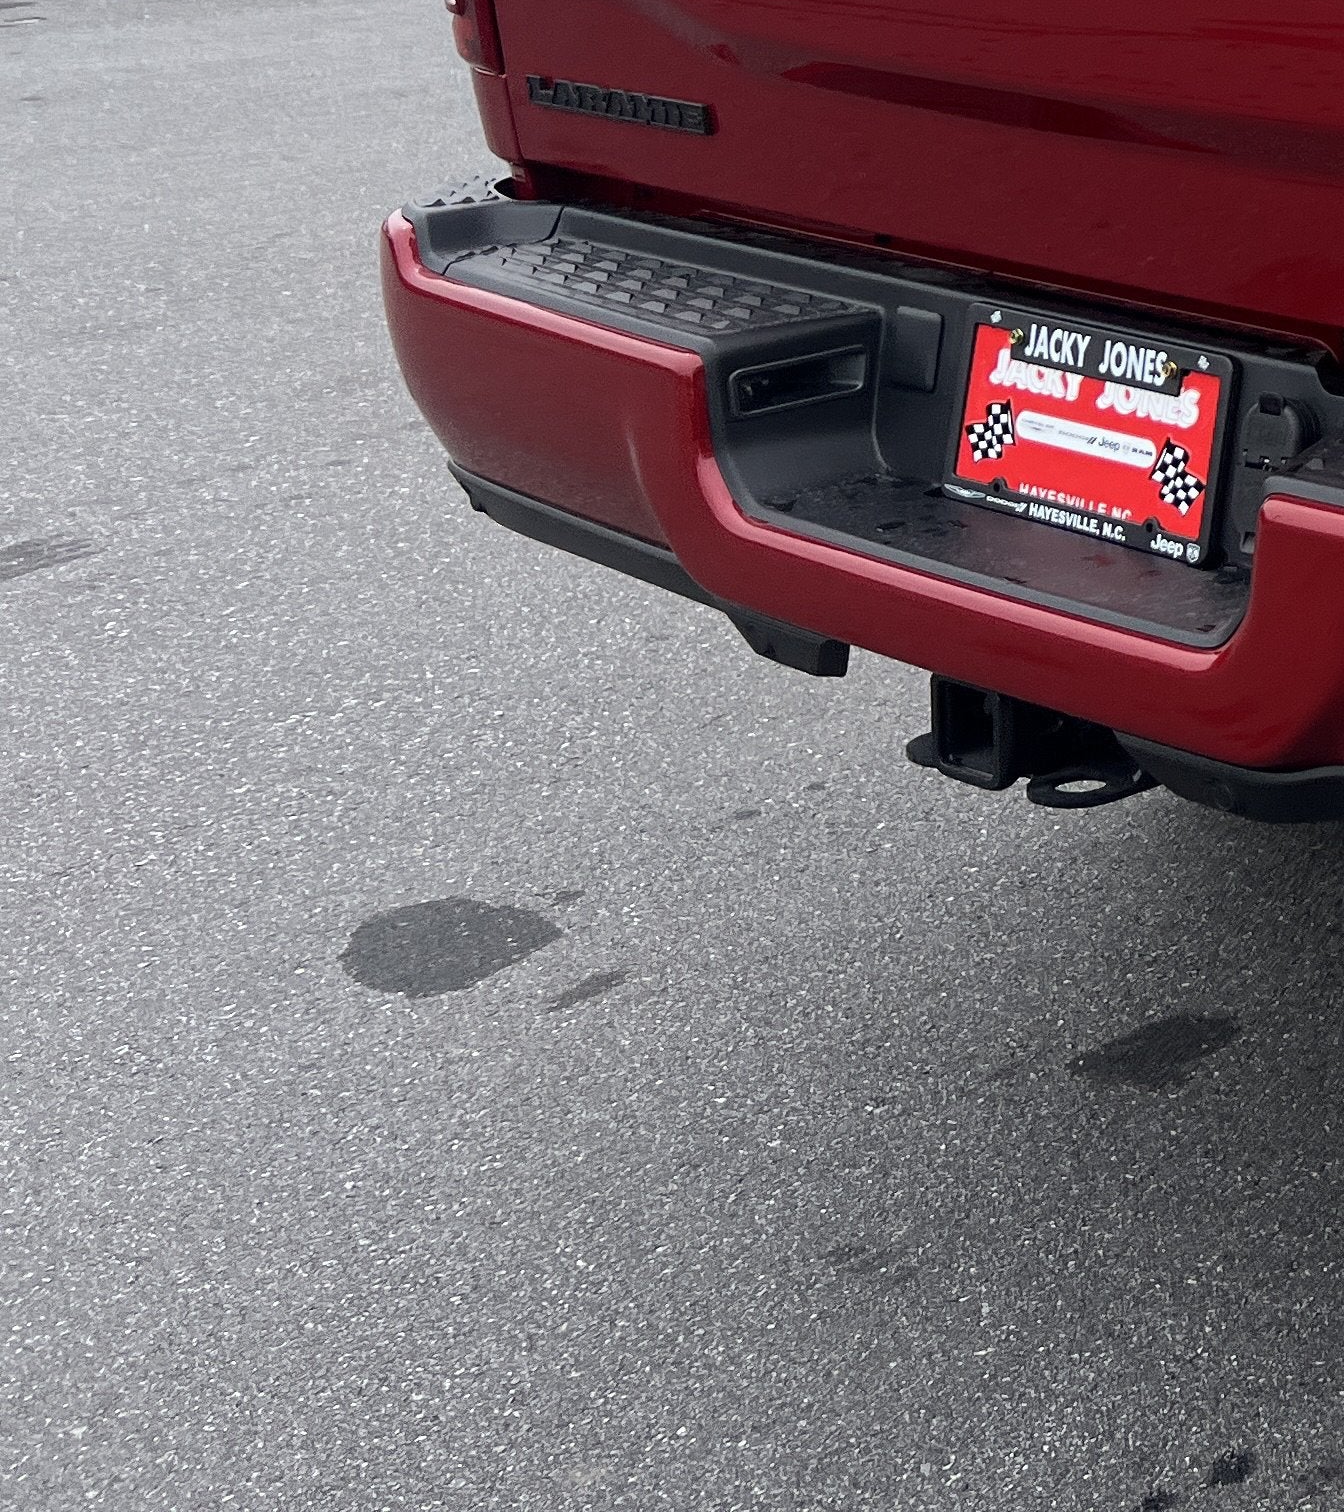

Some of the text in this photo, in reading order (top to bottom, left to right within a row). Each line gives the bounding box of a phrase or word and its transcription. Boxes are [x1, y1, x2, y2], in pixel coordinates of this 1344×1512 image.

[527, 75, 710, 134] LARAMIE
[1024, 323, 1168, 386] JACKY JONES
[1028, 502, 1126, 542] HAYESVILLE, N.C.
[1150, 534, 1184, 559] Jeep
